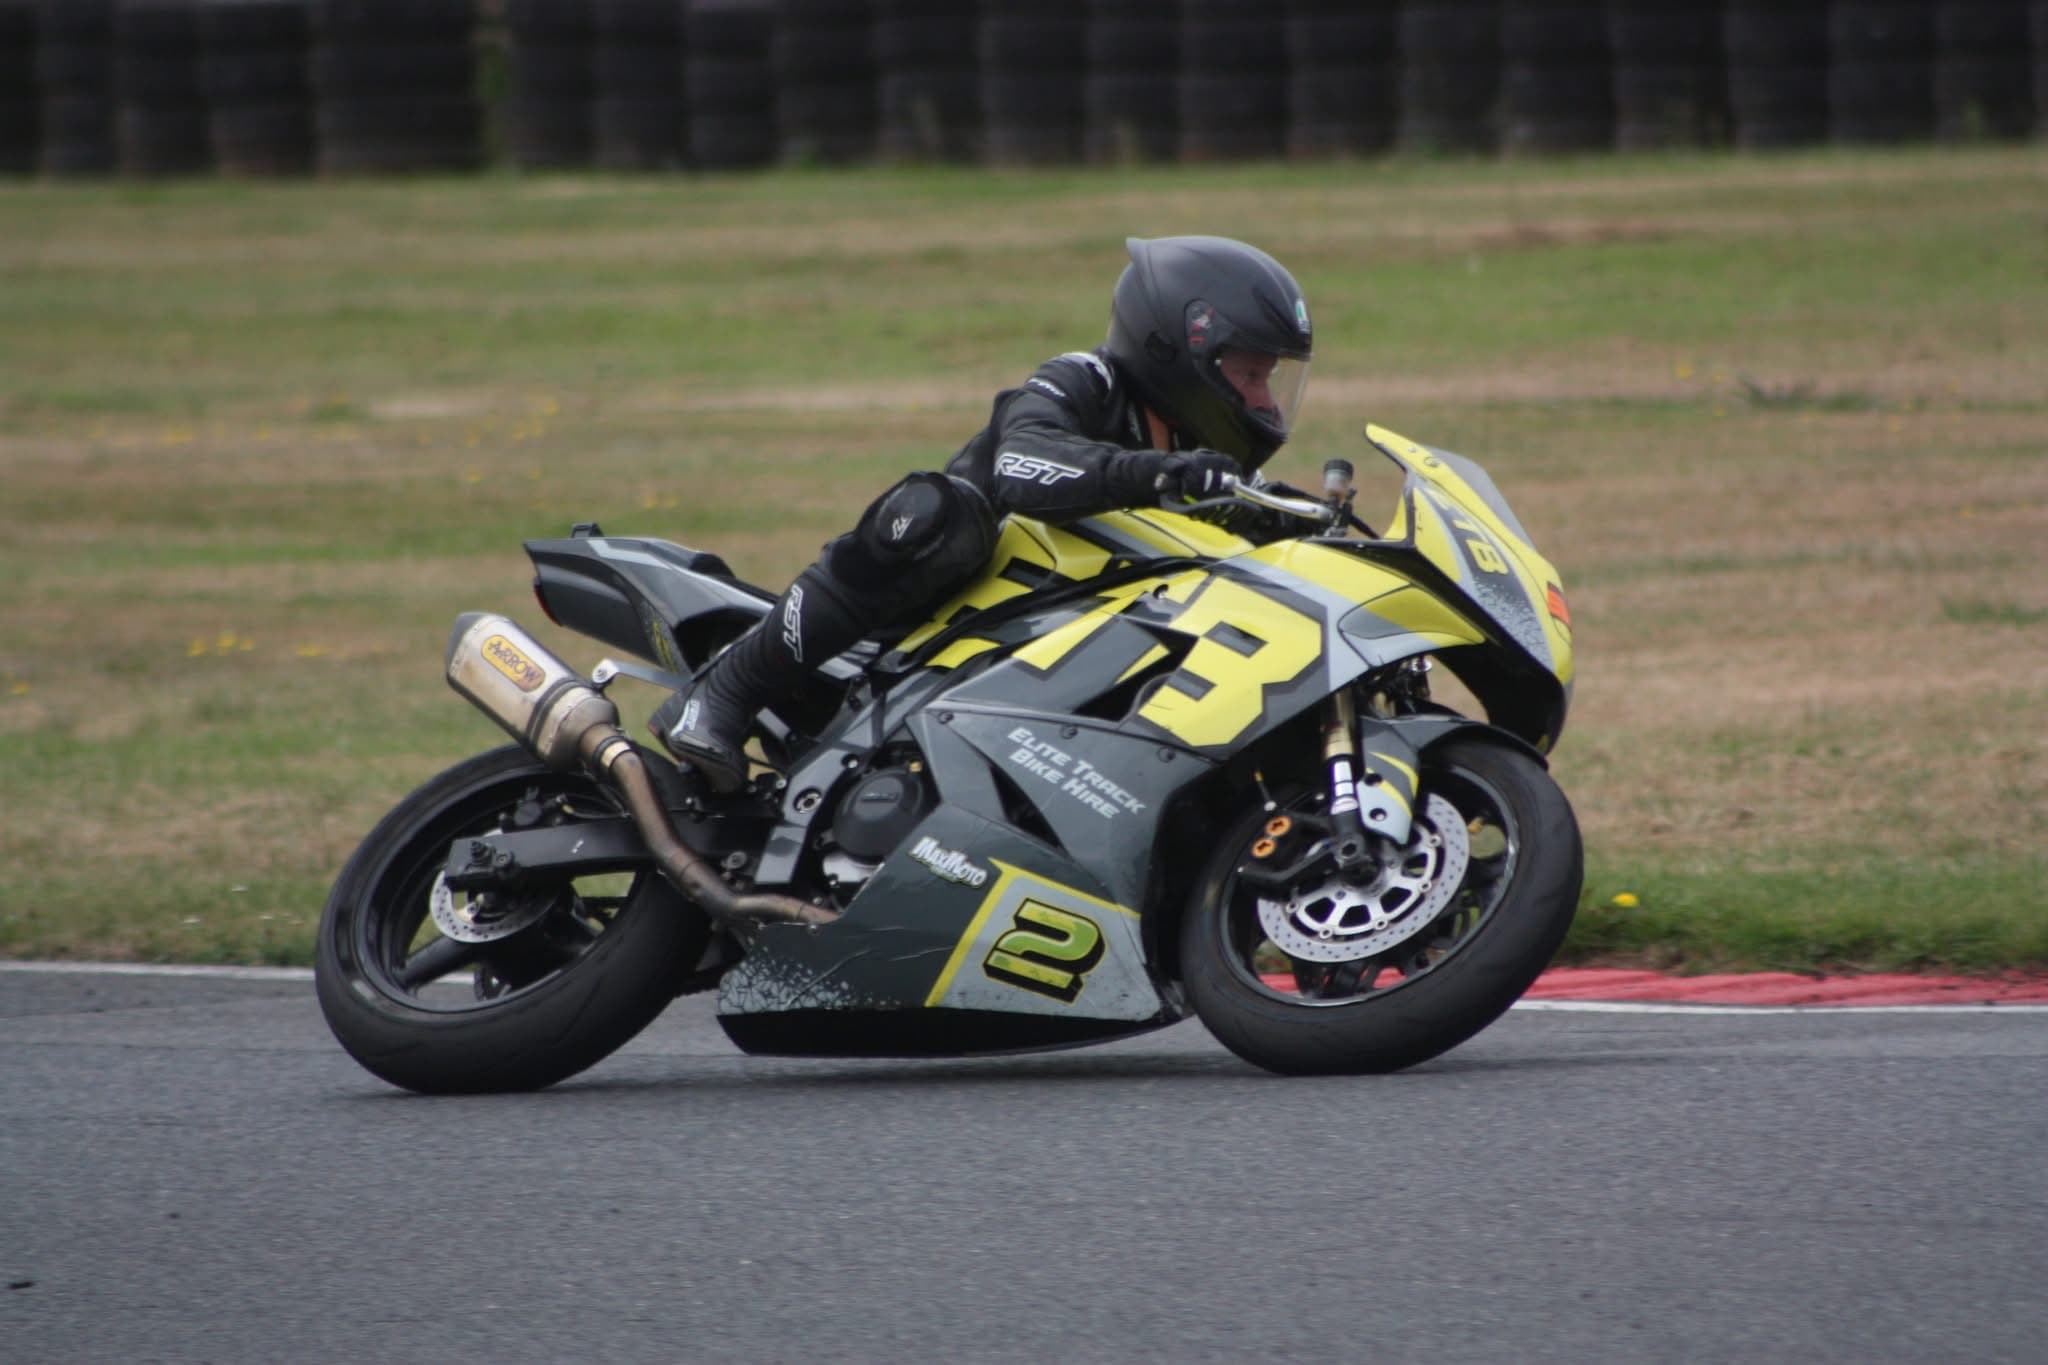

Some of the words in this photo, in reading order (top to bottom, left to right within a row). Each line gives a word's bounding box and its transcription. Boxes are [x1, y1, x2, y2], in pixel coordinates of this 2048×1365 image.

[993, 451, 1086, 486] RST
[782, 583, 803, 663] RST
[487, 640, 541, 683] ARROW
[1007, 727, 1072, 767] ELITE
[1072, 759, 1147, 815] TRACK
[1008, 747, 1065, 784] BIKE
[1061, 777, 1120, 819] HIRE
[983, 898, 1105, 1004] 2
